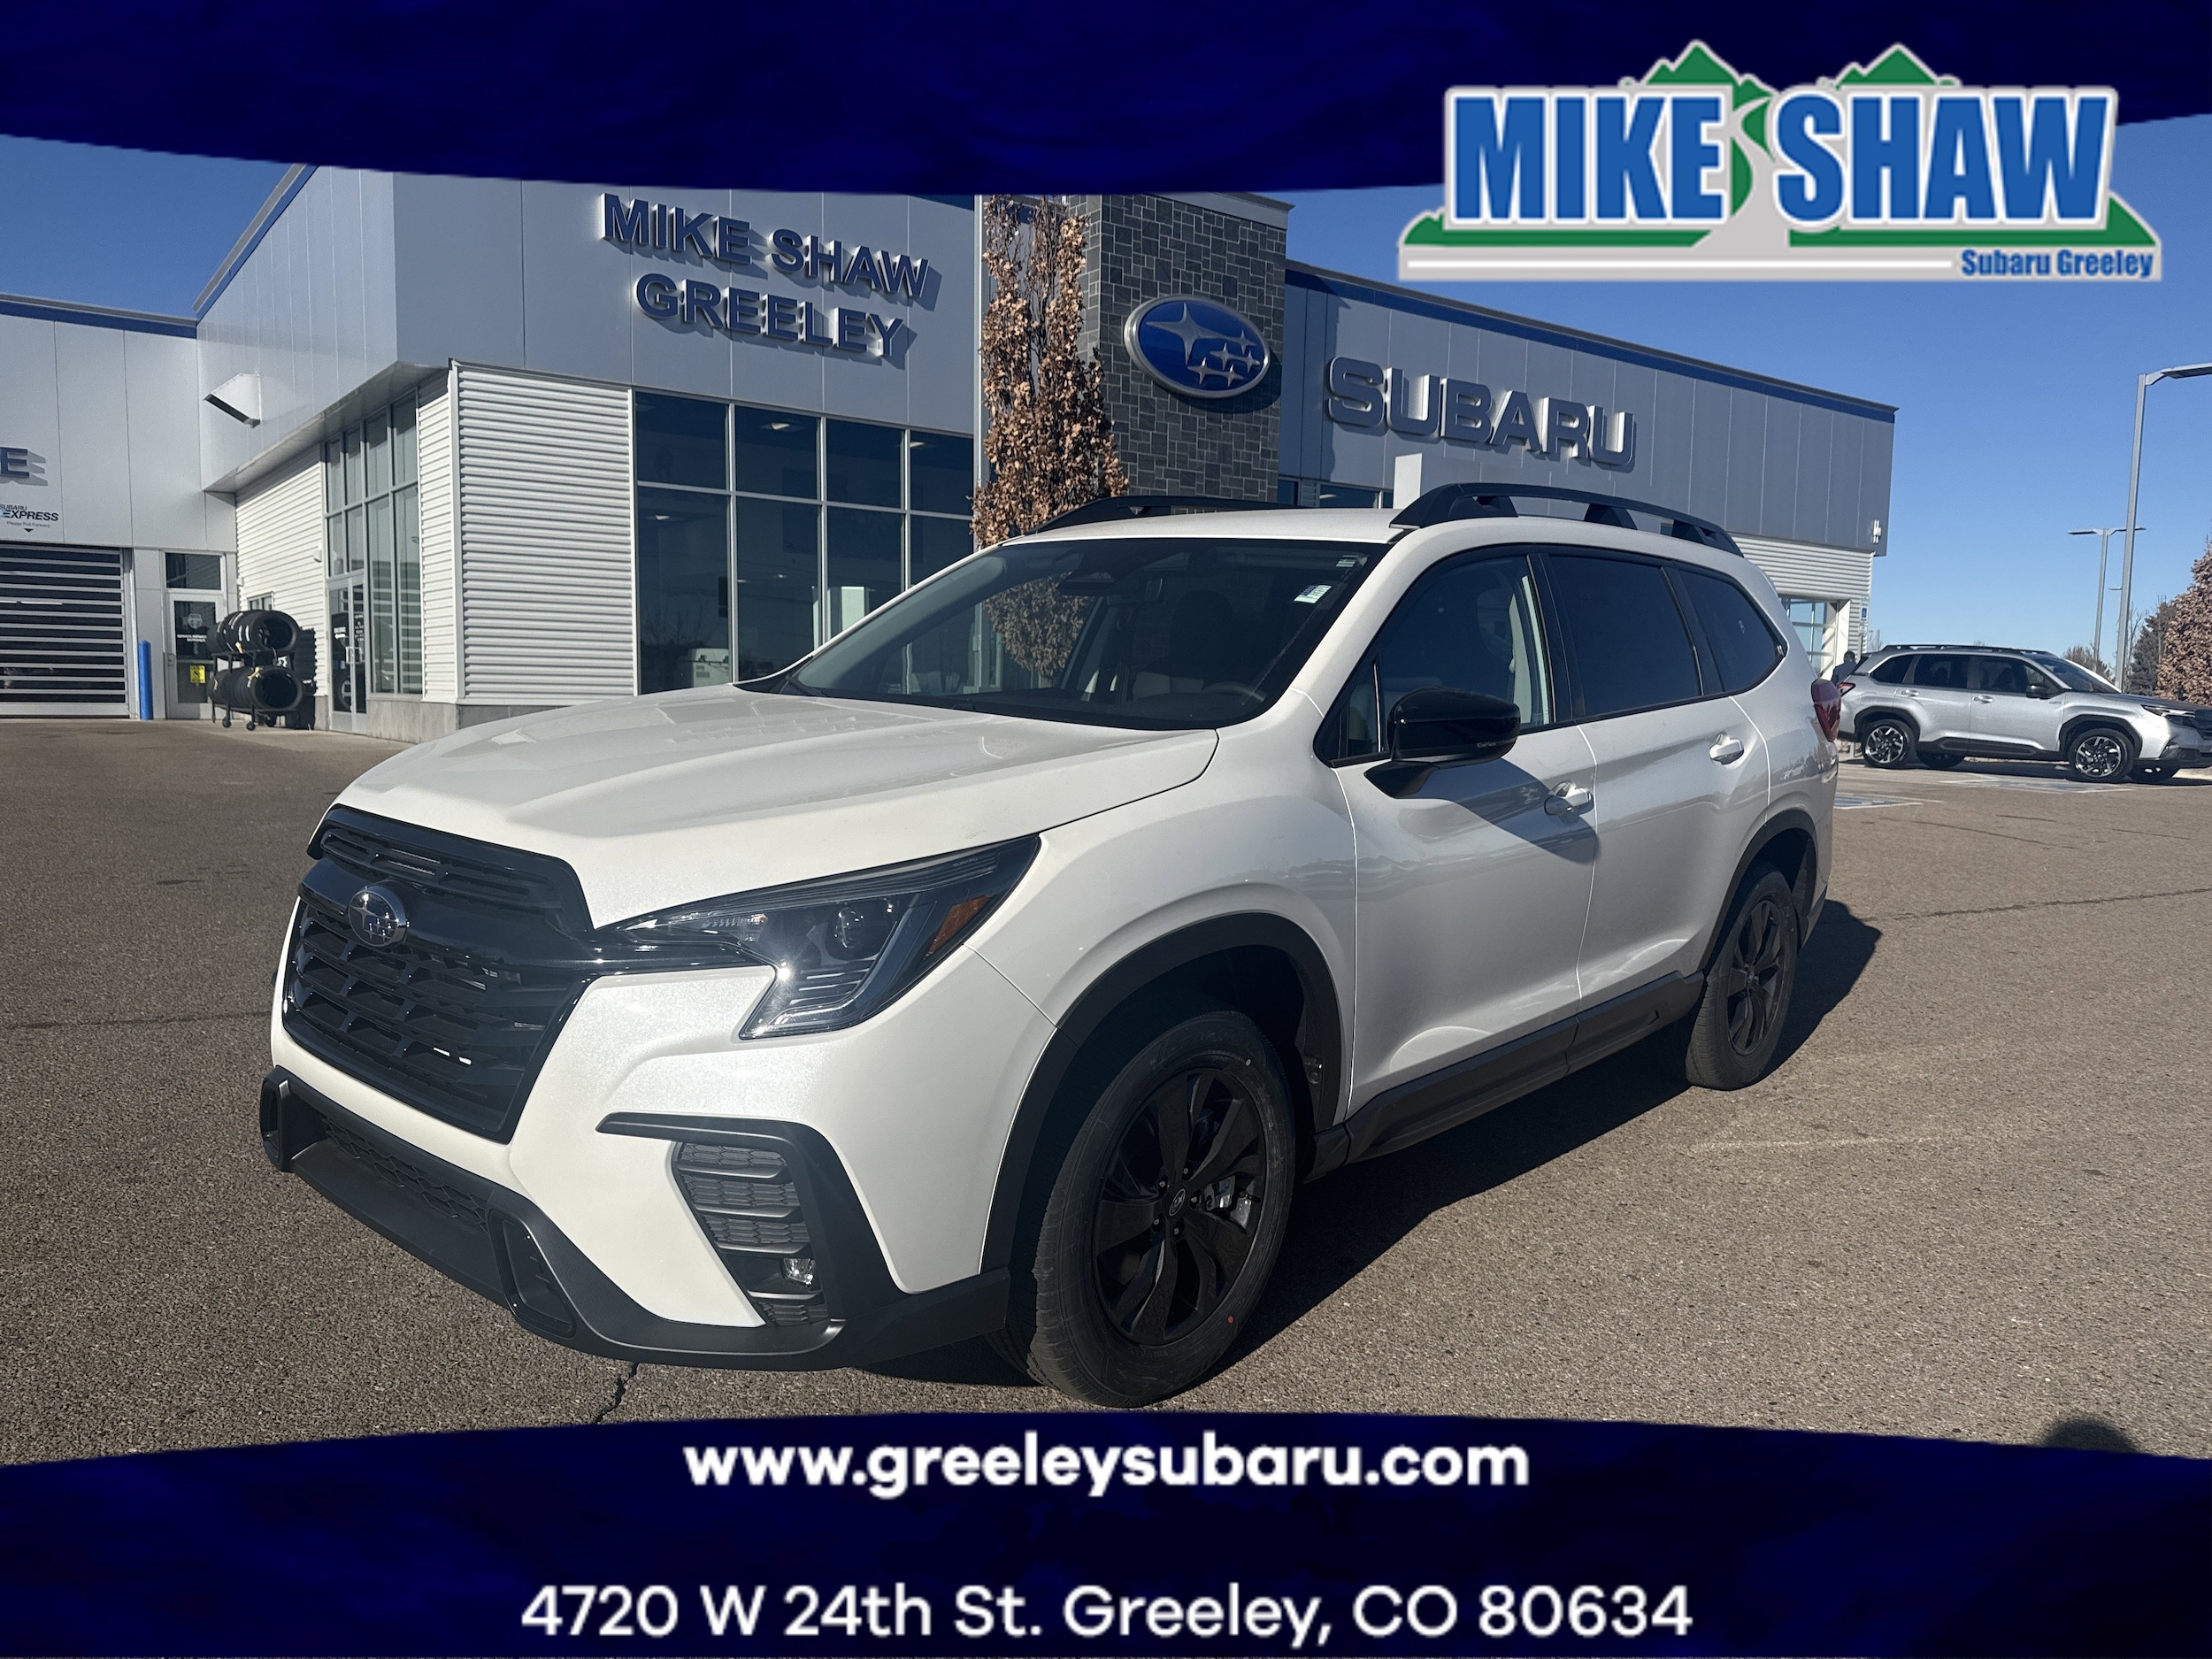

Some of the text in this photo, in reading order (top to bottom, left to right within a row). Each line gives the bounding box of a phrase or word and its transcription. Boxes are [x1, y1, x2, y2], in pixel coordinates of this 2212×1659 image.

[601, 193, 929, 298] MIKE SHAW
[634, 273, 904, 357] GREELEY
[1328, 357, 1636, 465] SUBARU
[3, 510, 59, 521] EXPRESS
